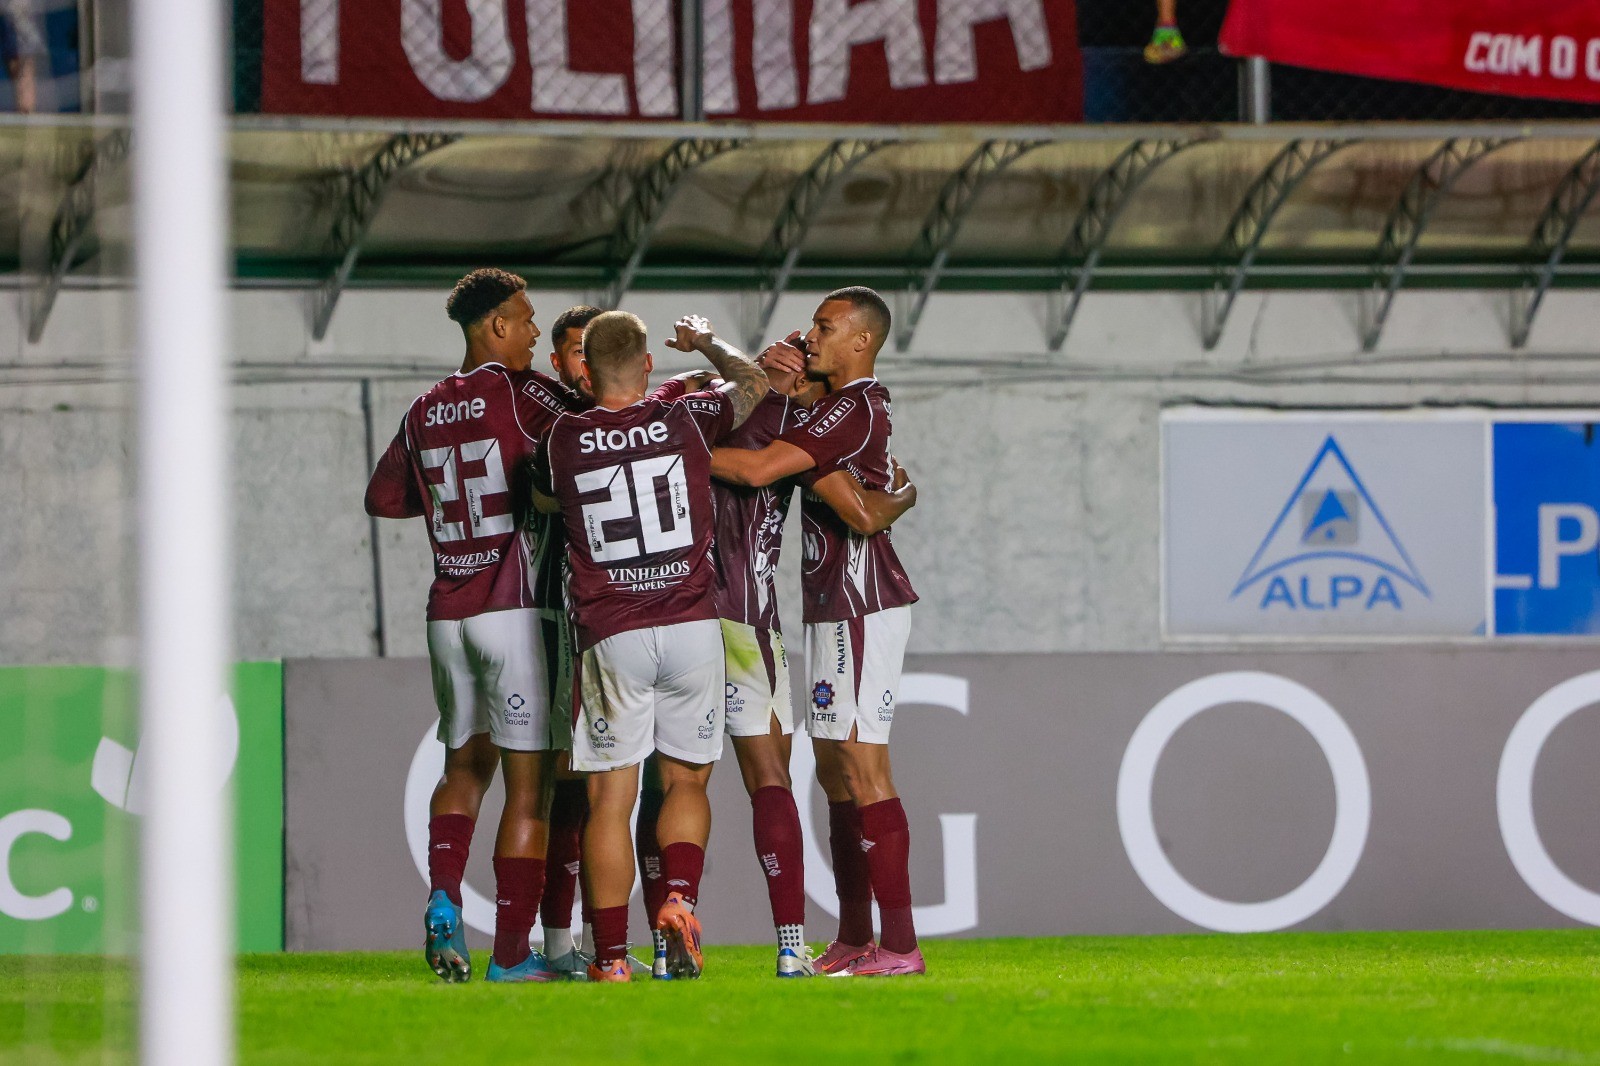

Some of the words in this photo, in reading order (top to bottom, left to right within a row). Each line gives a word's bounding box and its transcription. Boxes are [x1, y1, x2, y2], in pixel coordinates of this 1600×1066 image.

[1464, 31, 1543, 77] COM
[425, 397, 486, 428] stone
[528, 385, 566, 413] G.PANIZ
[814, 401, 852, 433] G.PANIZ
[579, 421, 669, 454] stone
[420, 437, 514, 543] 22
[574, 454, 694, 563] 20
[607, 560, 691, 582] VINHEDOS
[1260, 575, 1403, 610] ALPA
